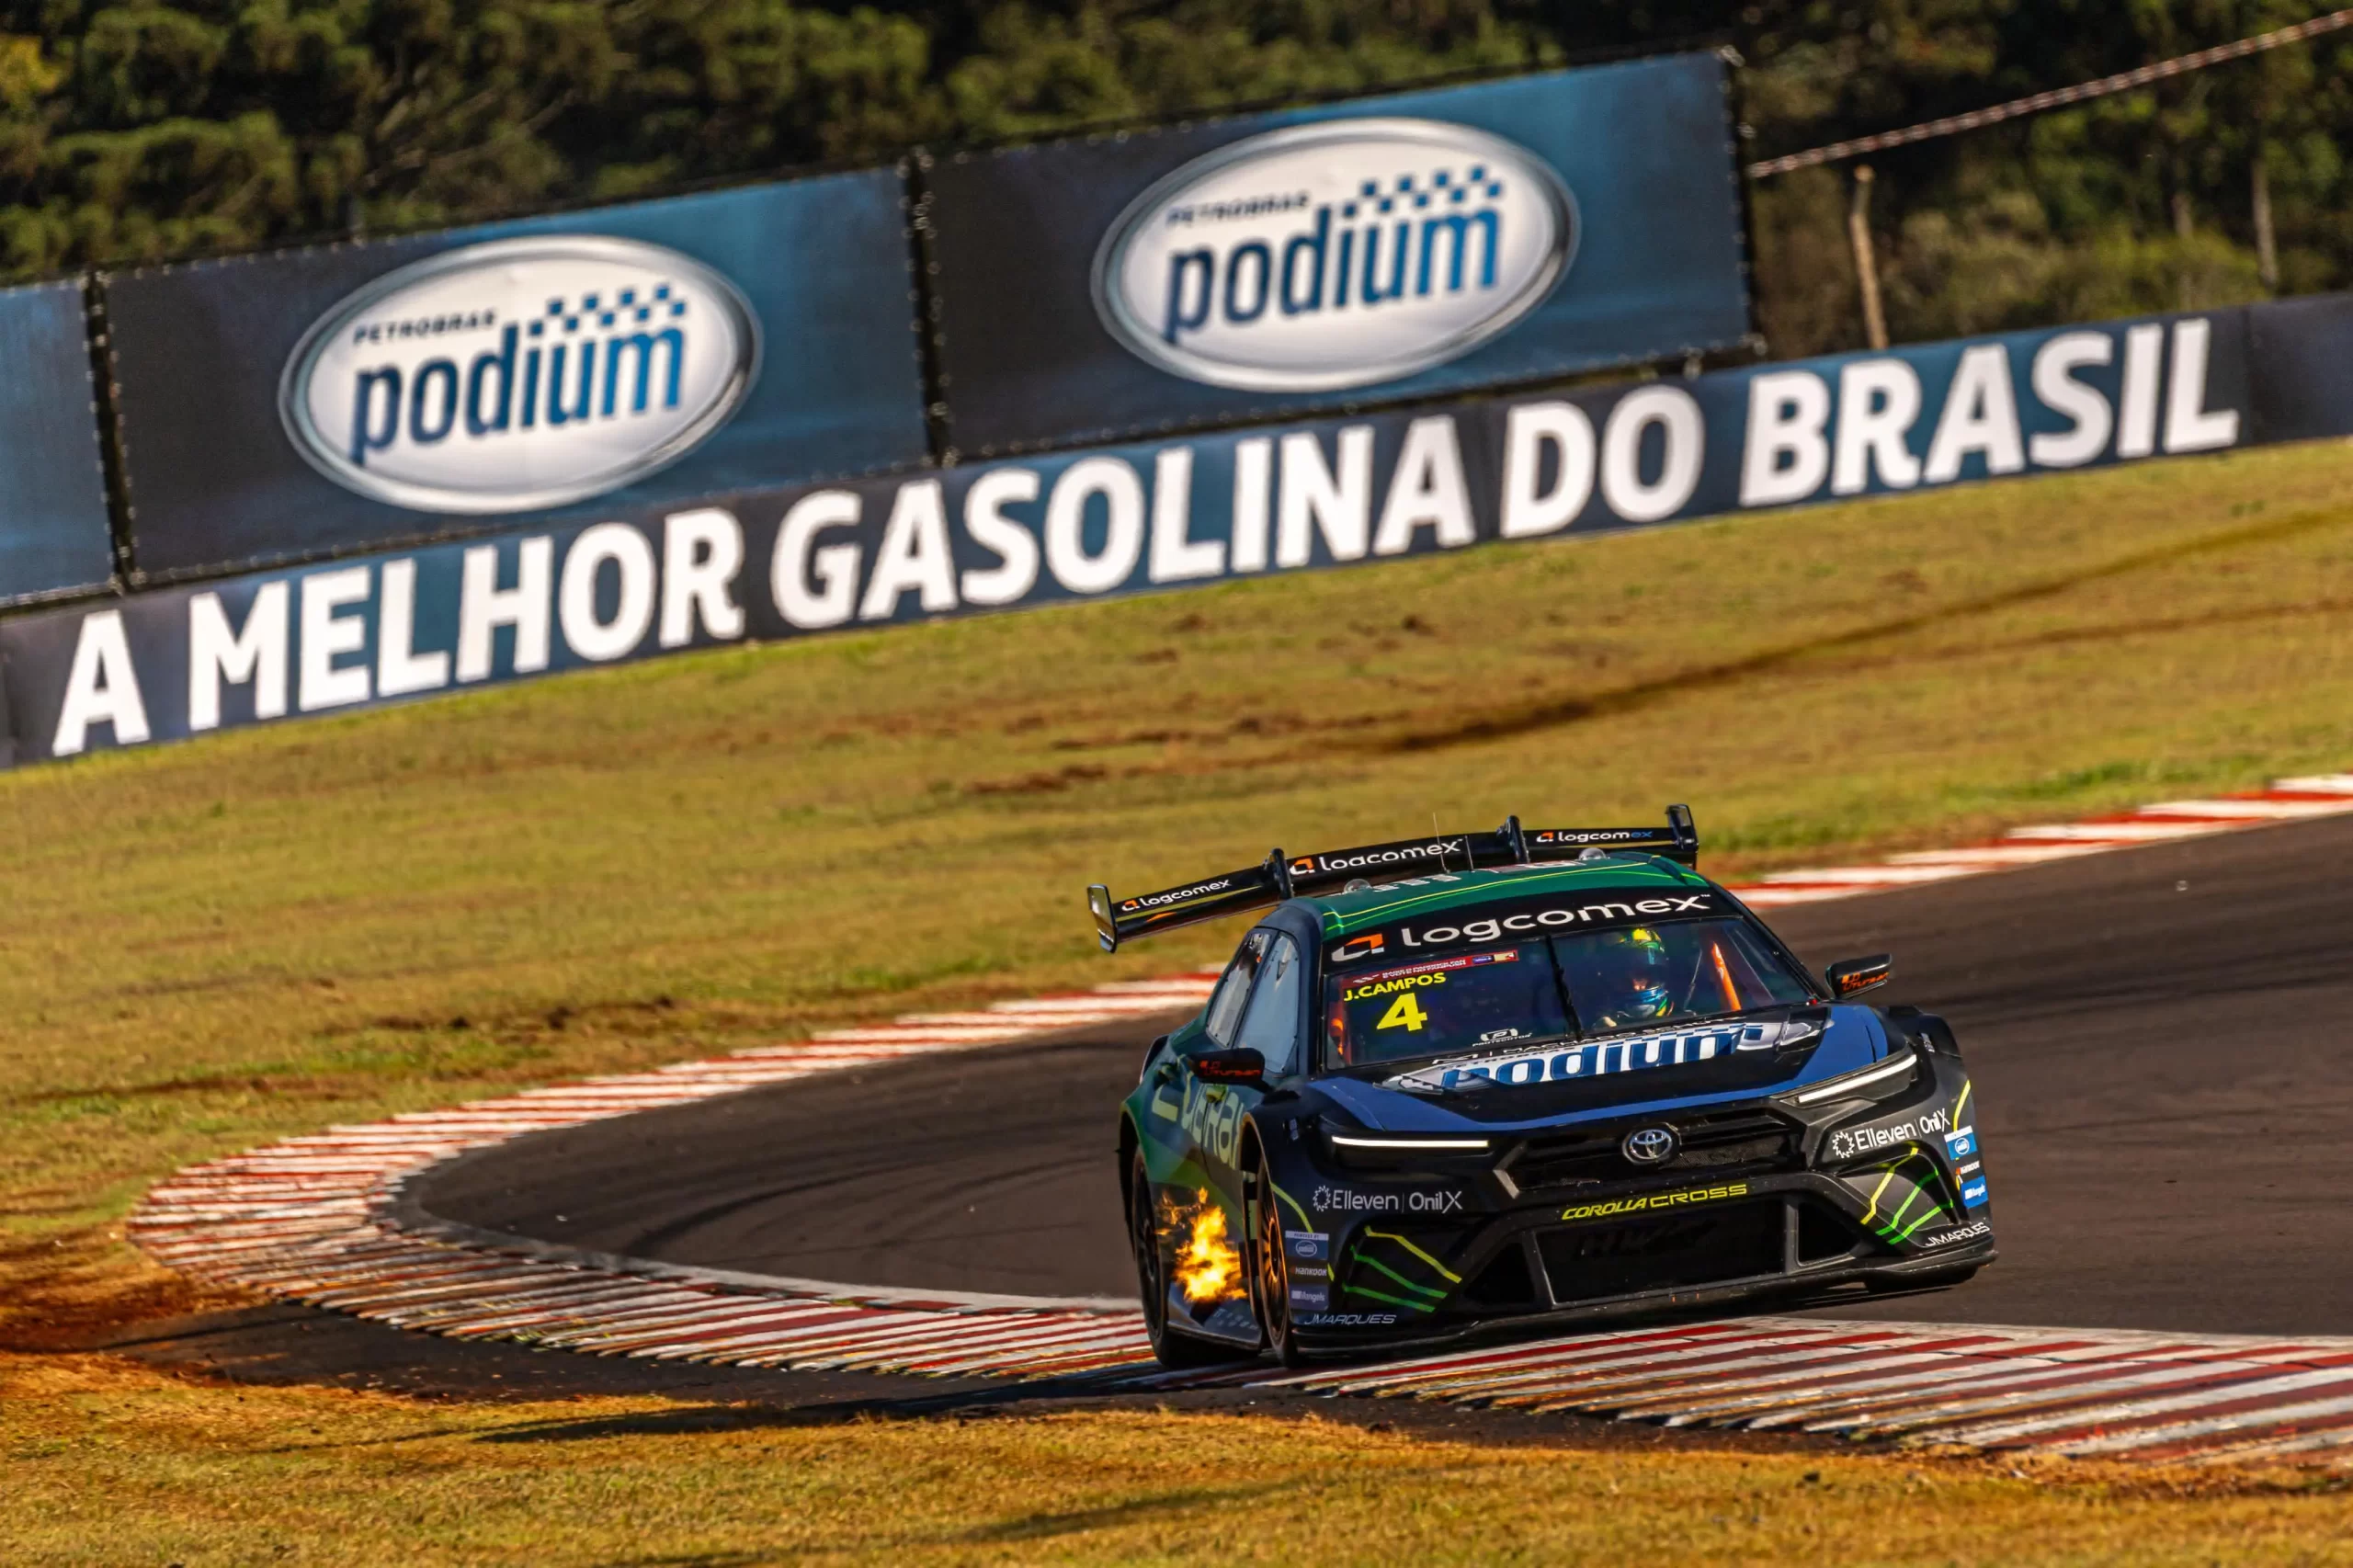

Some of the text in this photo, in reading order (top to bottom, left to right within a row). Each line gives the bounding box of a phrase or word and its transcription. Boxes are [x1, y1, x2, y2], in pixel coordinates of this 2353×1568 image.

[1165, 204, 1502, 345] podium
[353, 308, 496, 345] PETROBRAS
[349, 322, 687, 466] podium
[51, 317, 2239, 757] A MELHOR GASOLINA DO BRASIL
[1558, 830, 1654, 843] logcomex
[1140, 879, 1233, 906] logcomex
[1402, 894, 1711, 948] logcomex
[1343, 972, 1447, 1002] J.CAMPOS
[1376, 993, 1427, 1032] 4
[1854, 1123, 1917, 1151] Elleven
[1333, 1189, 1399, 1210] Elleven
[1562, 1184, 1746, 1220] COROLLA CROSS
